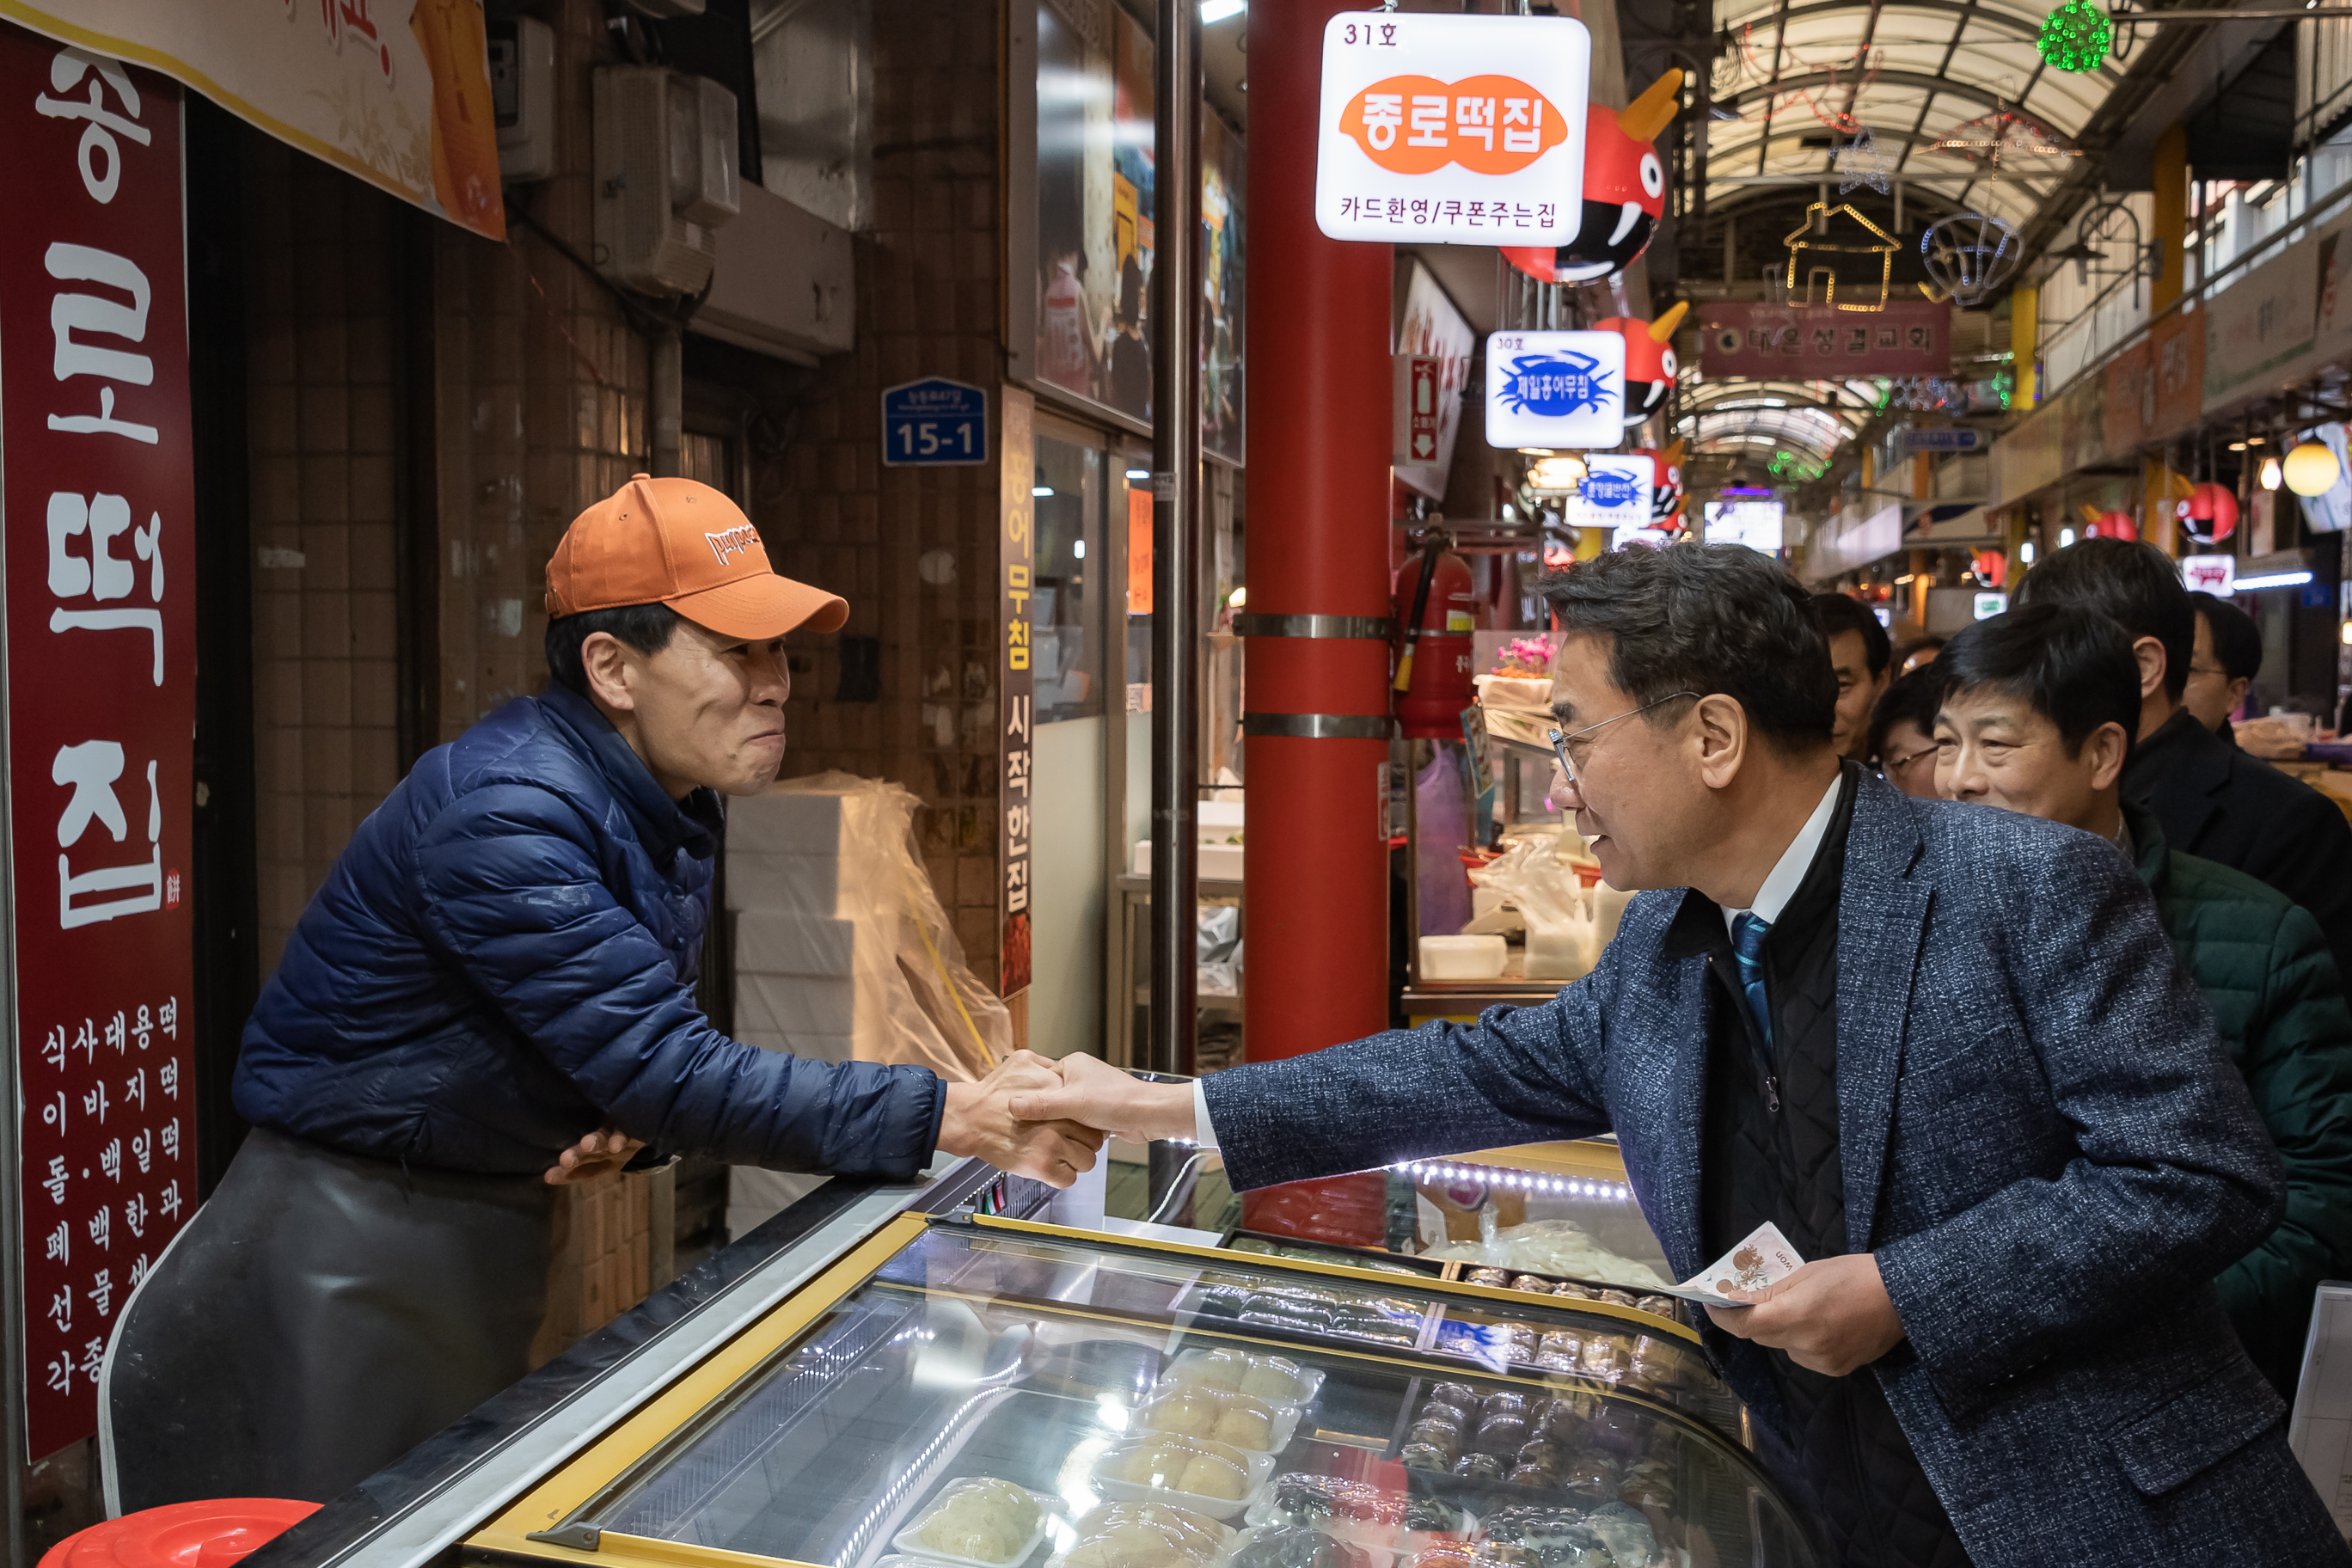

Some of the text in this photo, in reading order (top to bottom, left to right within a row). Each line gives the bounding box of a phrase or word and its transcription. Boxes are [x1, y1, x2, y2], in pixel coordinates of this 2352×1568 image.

[1344, 23, 1397, 46] 31호
[1362, 93, 1543, 153] 종로떡집
[1340, 197, 1555, 228] 카드환영/쿠폰주는집
[1517, 374, 1589, 401] 제일홍어무침
[897, 423, 972, 455] 15-1
[34, 45, 165, 930] 종로떡집
[1007, 695, 1030, 914] 시작한집
[41, 996, 178, 1073] 식사대용떡
[43, 1057, 179, 1137] 이바지떡
[46, 1179, 183, 1267] 폐백한과
[1775, 1250, 1793, 1271] won
